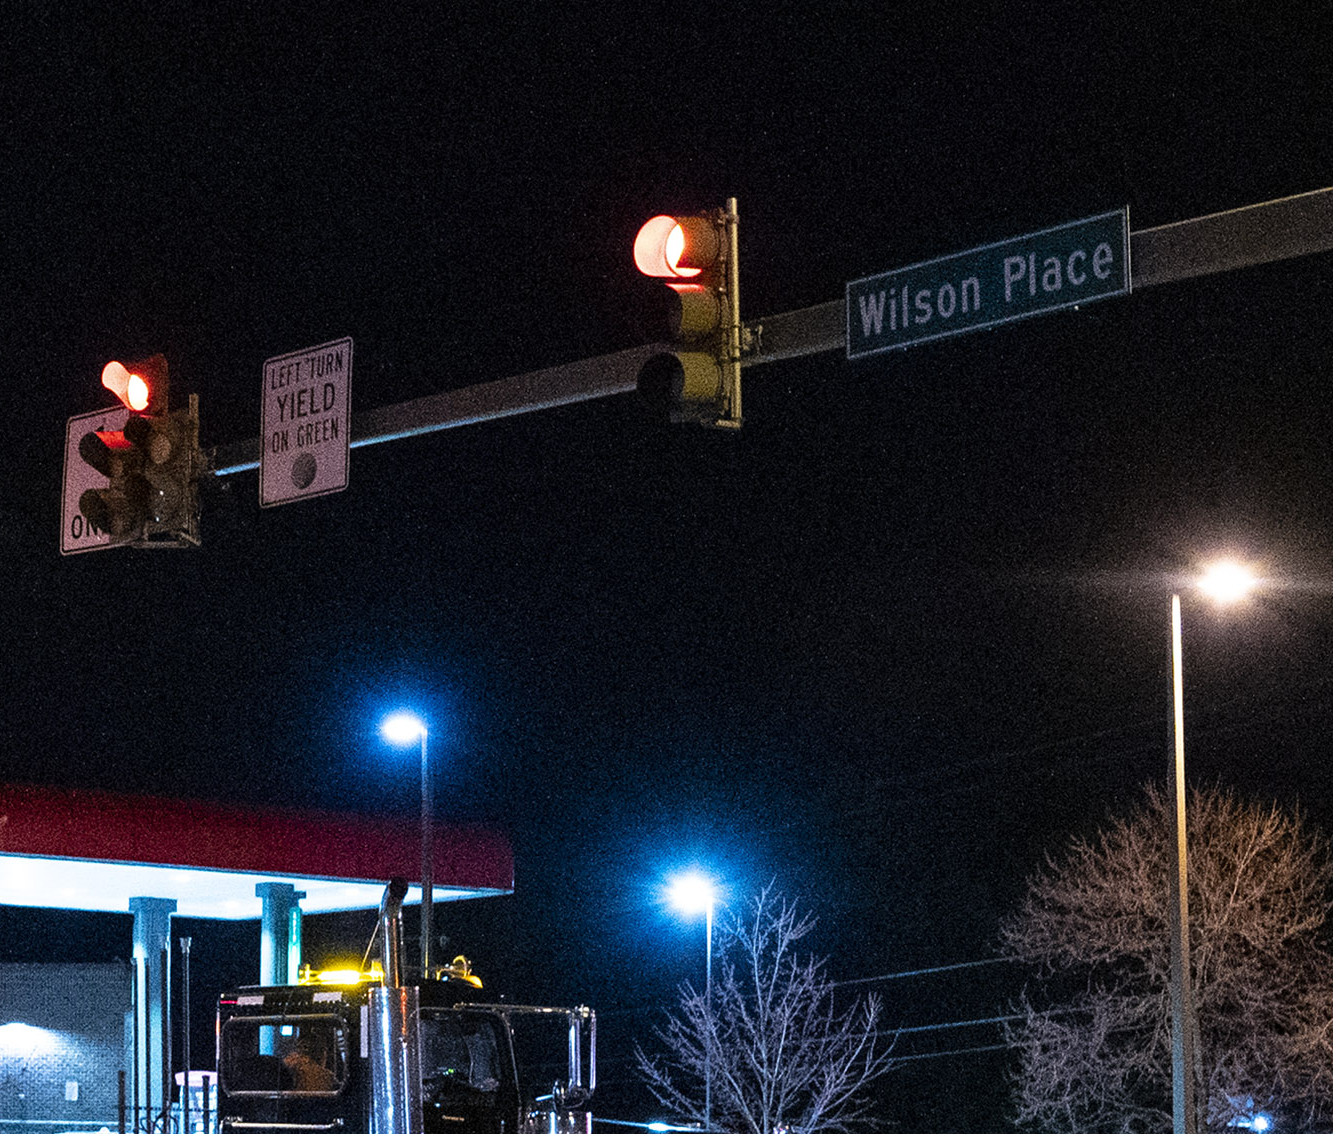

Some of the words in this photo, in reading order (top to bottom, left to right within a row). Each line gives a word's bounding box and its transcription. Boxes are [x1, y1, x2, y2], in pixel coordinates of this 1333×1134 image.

[859, 276, 981, 338] Wilson
[1003, 242, 1114, 302] Place
[270, 359, 302, 390] LEFT
[307, 350, 344, 380] TURN
[276, 382, 336, 423] YIELD
[271, 431, 289, 454] ON
[297, 418, 339, 448] GREEN
